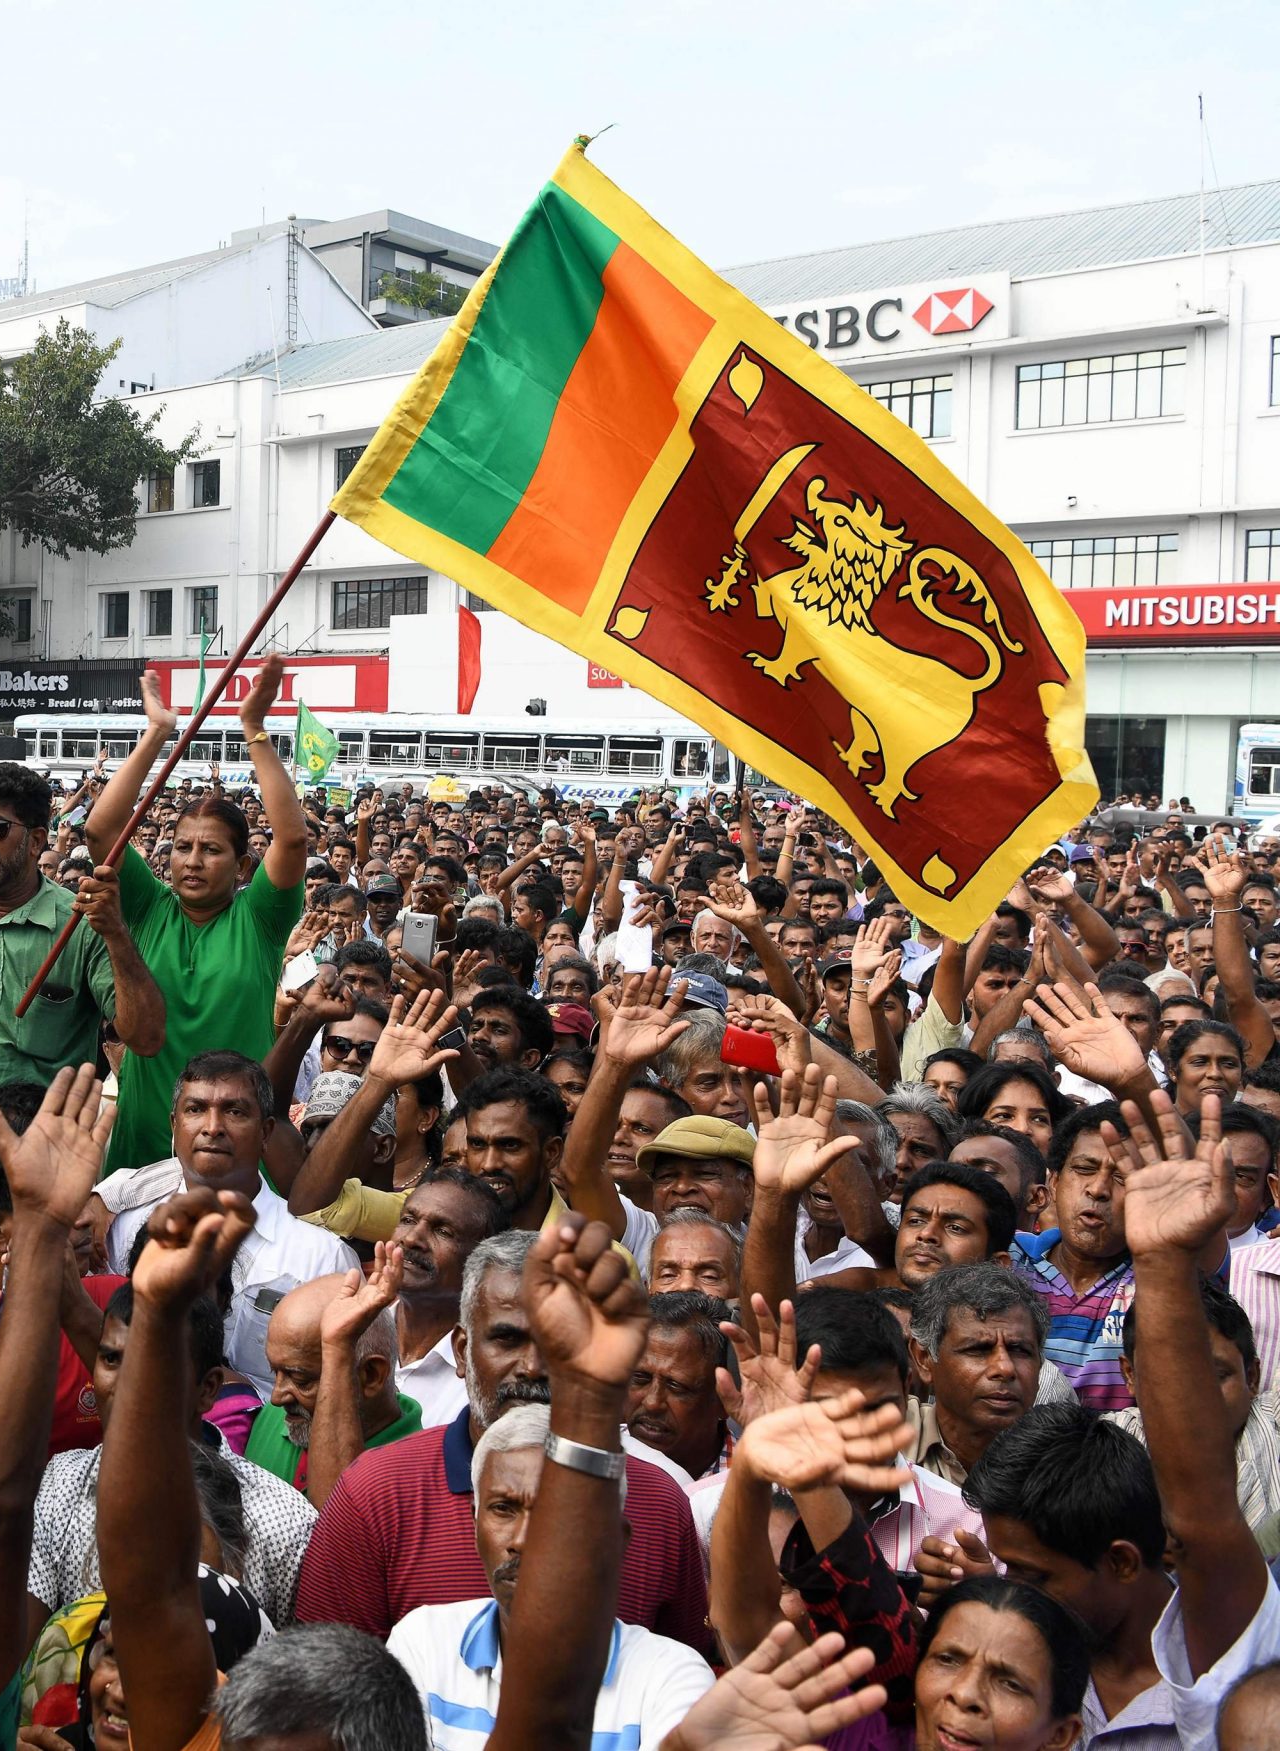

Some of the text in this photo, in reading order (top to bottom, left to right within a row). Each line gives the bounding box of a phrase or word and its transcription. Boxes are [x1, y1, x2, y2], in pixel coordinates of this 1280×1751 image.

[773, 297, 903, 349] SBC
[1105, 594, 1280, 627] MITSUBISH
[0, 670, 69, 692] Bakers
[48, 698, 76, 707] Bread
[83, 698, 103, 708] cak
[112, 697, 143, 708] coffee
